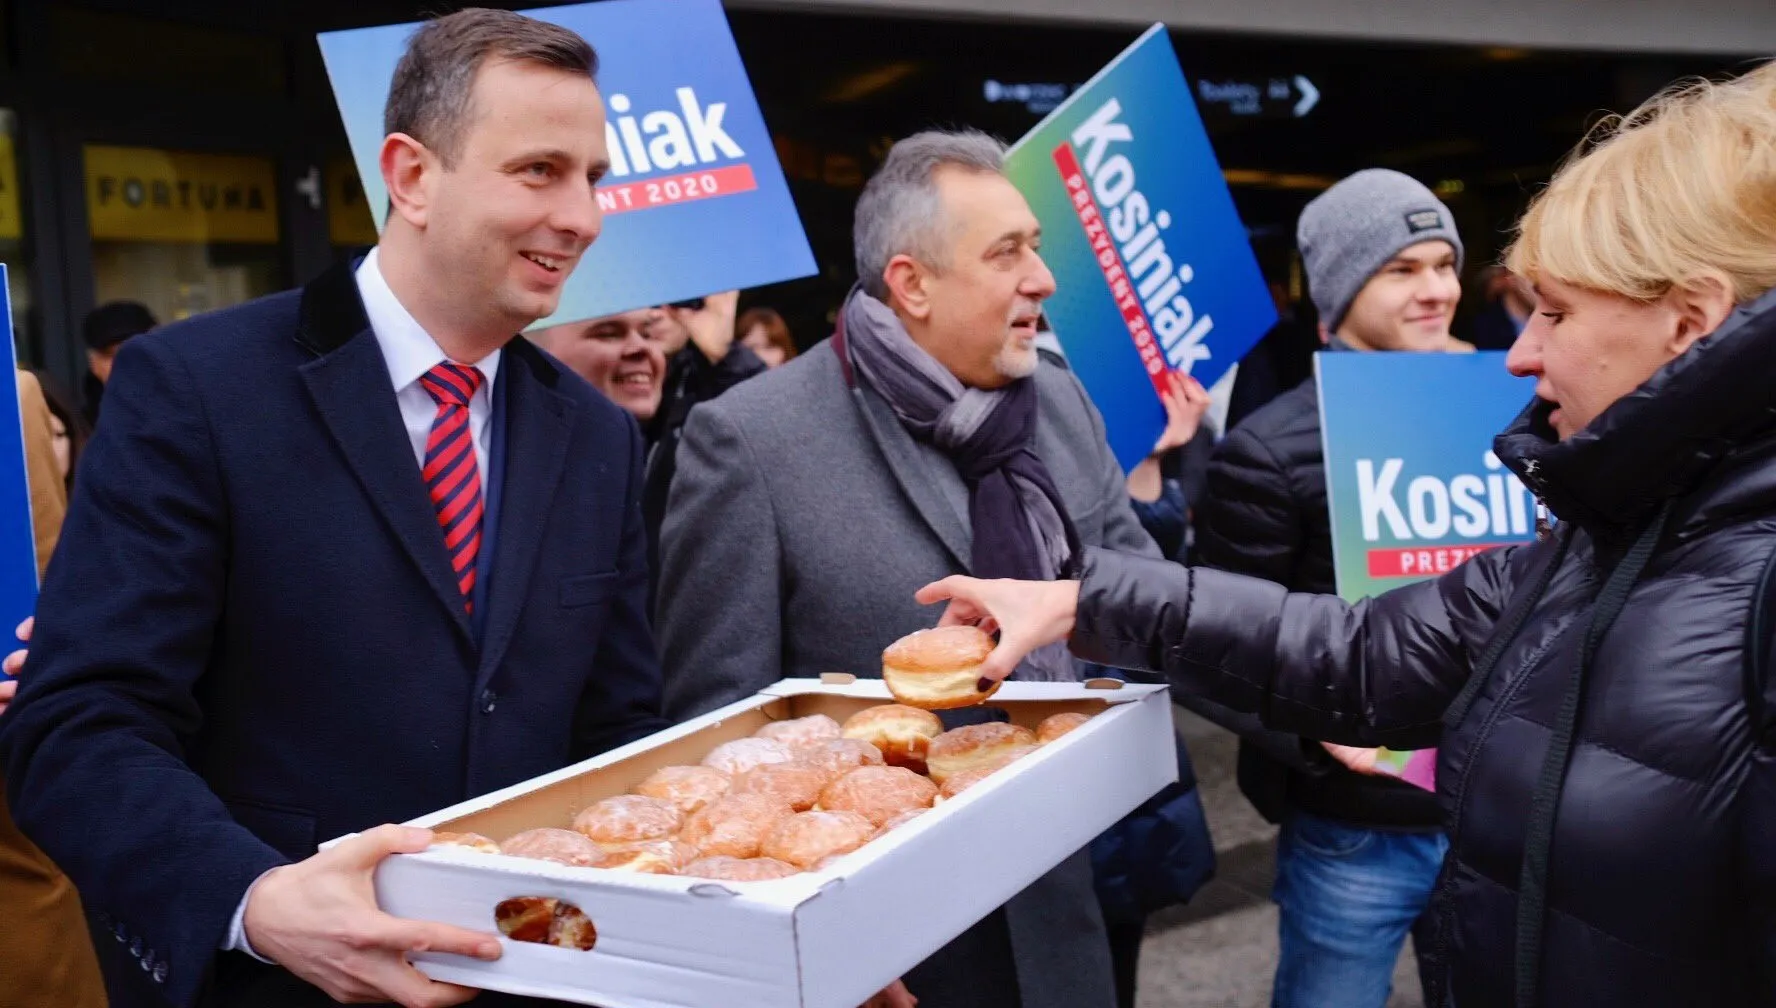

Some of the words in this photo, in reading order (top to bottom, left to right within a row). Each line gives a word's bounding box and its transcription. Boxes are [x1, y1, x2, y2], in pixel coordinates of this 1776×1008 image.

[646, 174, 719, 203] 2020
[1067, 173, 1137, 310] PREZYDENT
[1128, 315, 1163, 375] 2020
[1071, 98, 1214, 375] Kosiniak
